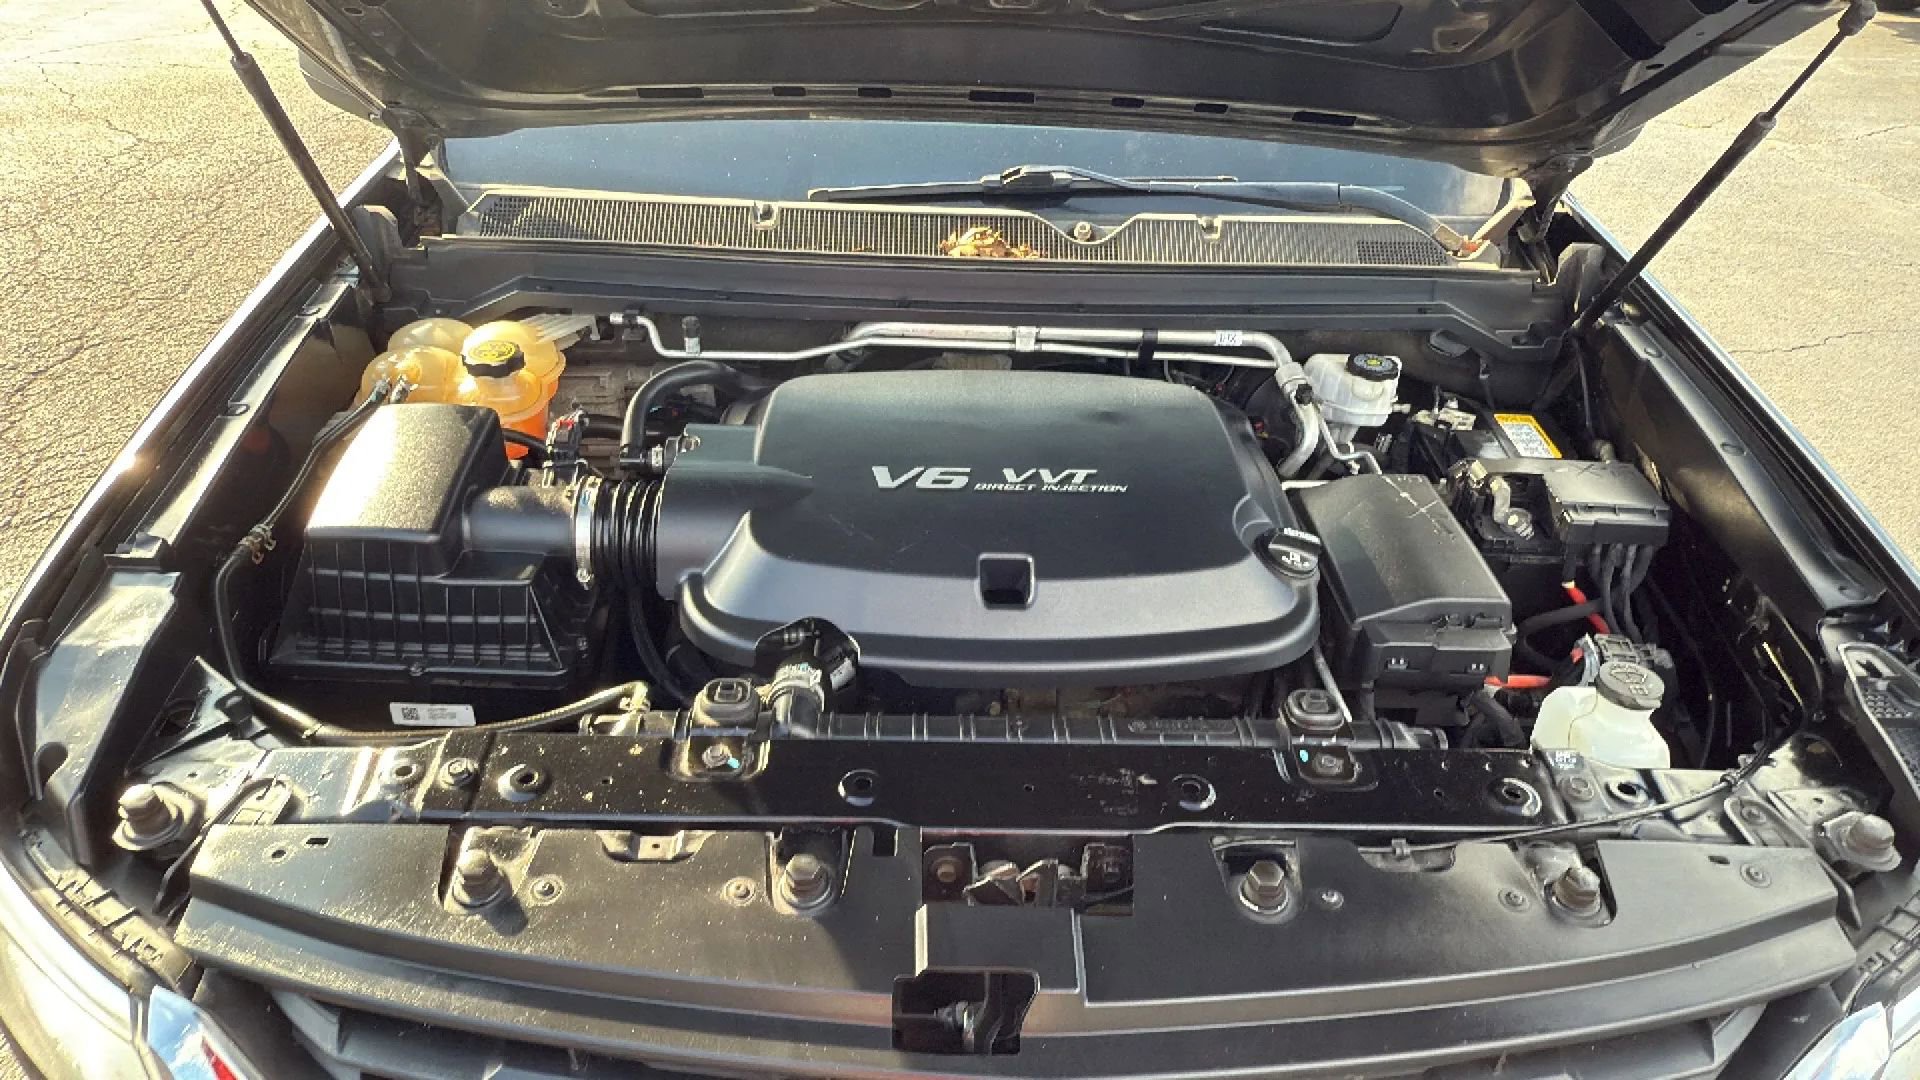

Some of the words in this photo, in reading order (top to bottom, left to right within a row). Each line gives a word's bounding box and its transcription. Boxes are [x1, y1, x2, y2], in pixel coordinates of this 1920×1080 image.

[871, 465, 971, 489] V6
[1002, 467, 1098, 485] VVT
[973, 483, 1037, 492] DIRECT
[1041, 483, 1129, 493] INJECTION
